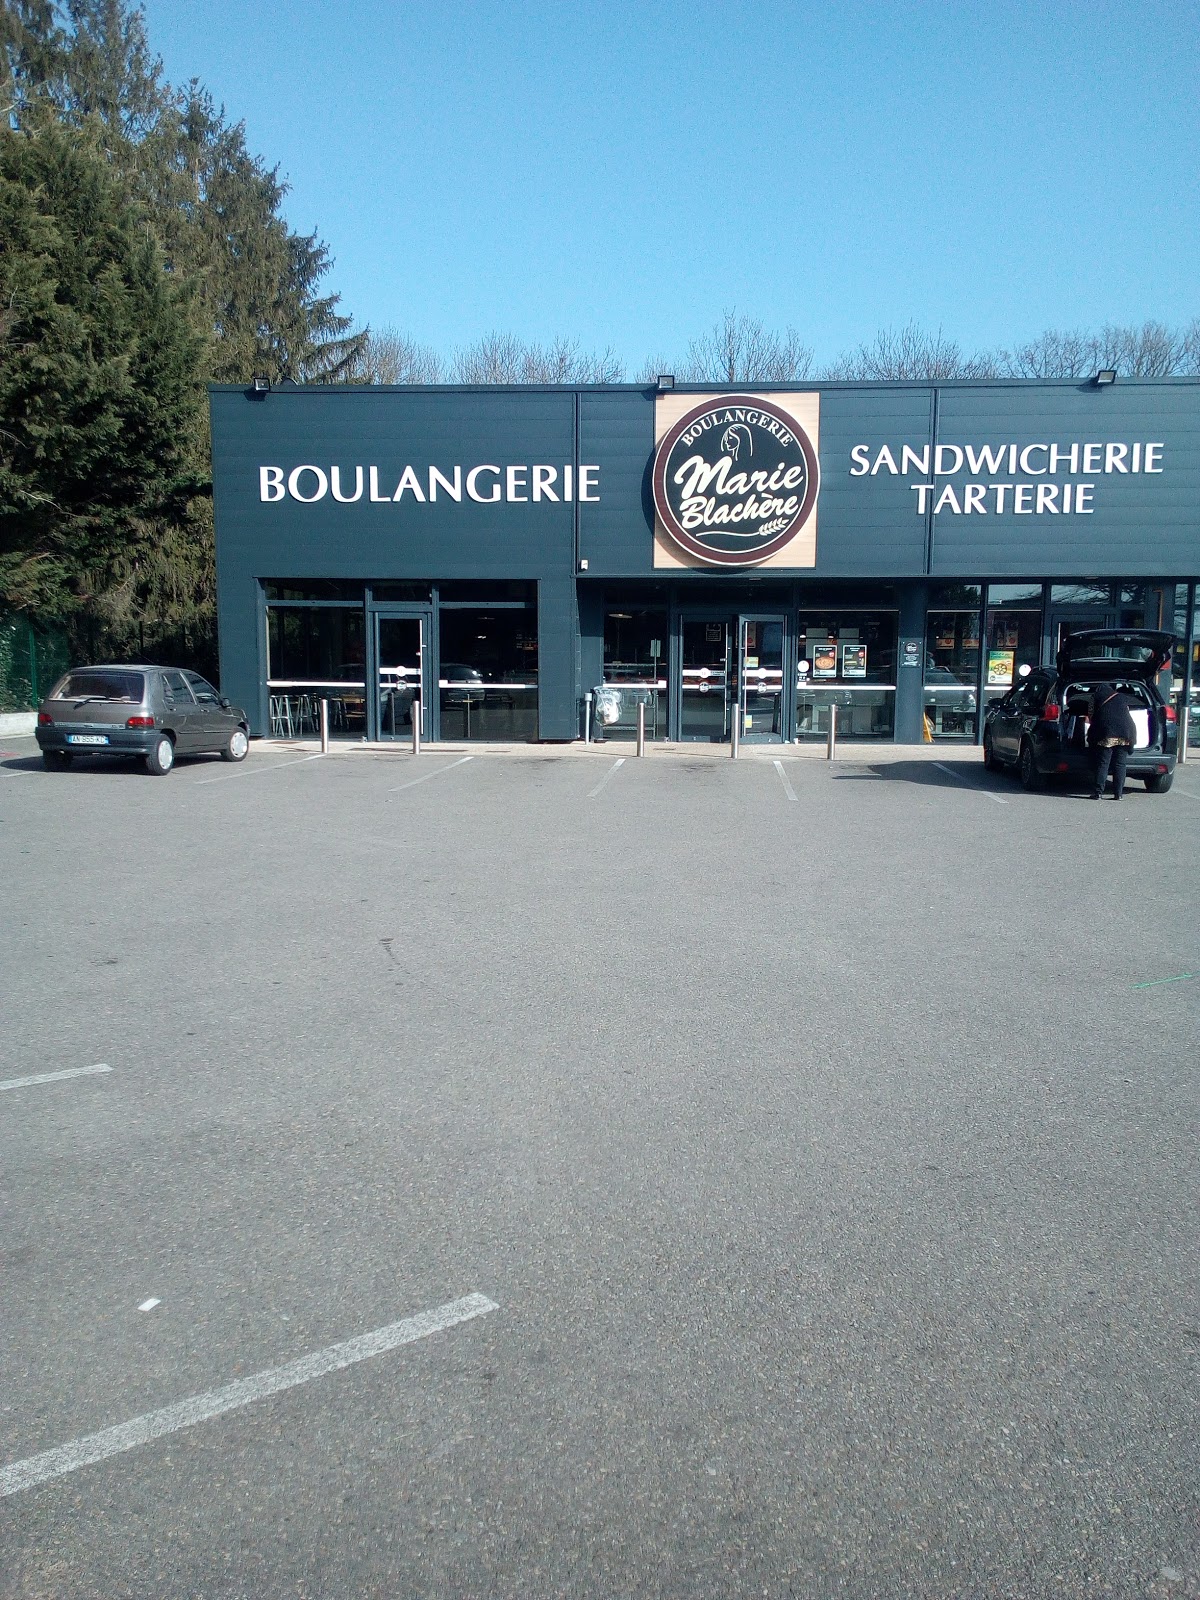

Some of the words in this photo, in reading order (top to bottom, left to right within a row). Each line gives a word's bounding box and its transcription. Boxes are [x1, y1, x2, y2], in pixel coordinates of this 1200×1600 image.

[680, 409, 794, 447] BOULANGERIE
[673, 455, 804, 500] Marie
[850, 442, 1165, 476] SANDWICHERIE
[258, 464, 601, 503] BOULANGERIE
[911, 483, 1095, 515] TARTERIE
[679, 493, 799, 530] Blachère
